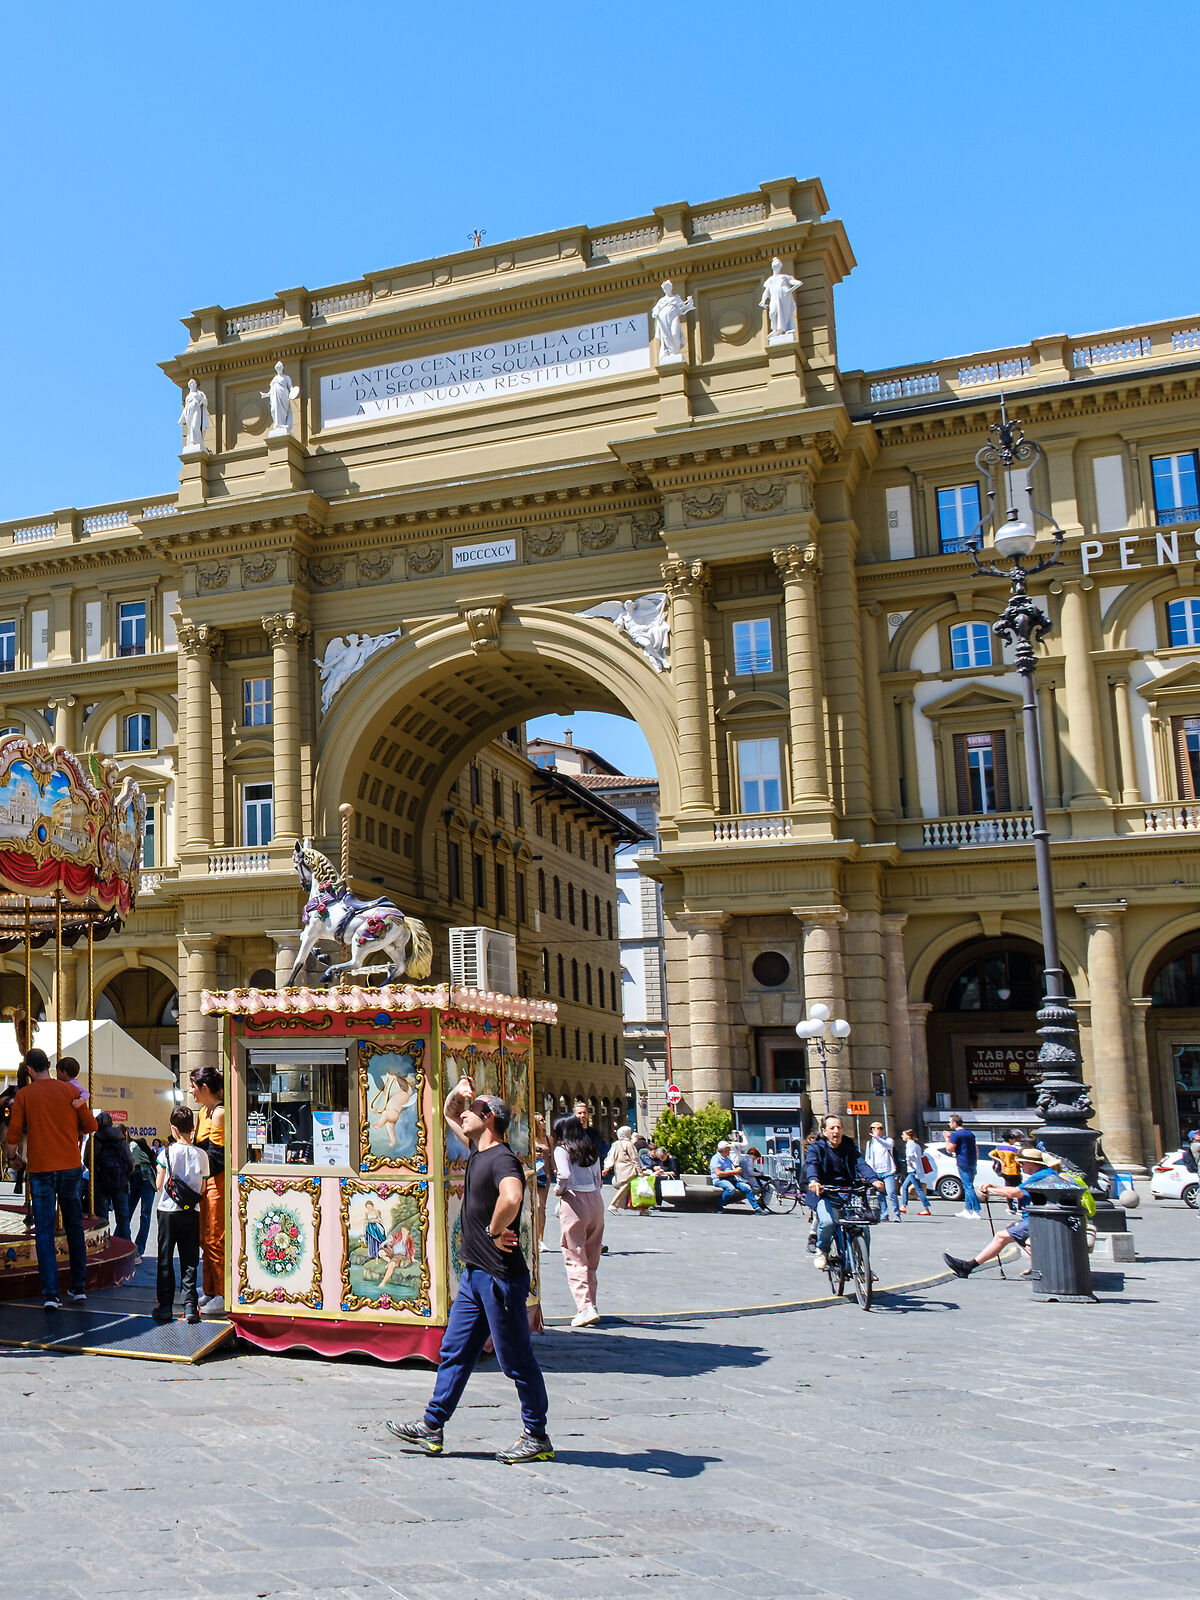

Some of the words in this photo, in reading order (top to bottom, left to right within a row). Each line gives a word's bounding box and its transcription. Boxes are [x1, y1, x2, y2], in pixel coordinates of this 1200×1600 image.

[349, 364, 414, 388] ANTICO
[421, 347, 496, 373] CENTRO
[504, 333, 569, 357] DELLA
[355, 386, 378, 401] DA
[386, 365, 483, 395] SECOLARE
[492, 341, 609, 374] SQUALLORE
[356, 404, 366, 416] A
[375, 394, 415, 411] VITA
[424, 381, 485, 403] NUOVA
[495, 357, 610, 390] RESTITUITO
[455, 545, 512, 563] MDCCCXCV
[977, 1050, 1041, 1060] TABACC
[139, 1127, 157, 1136] 2023
